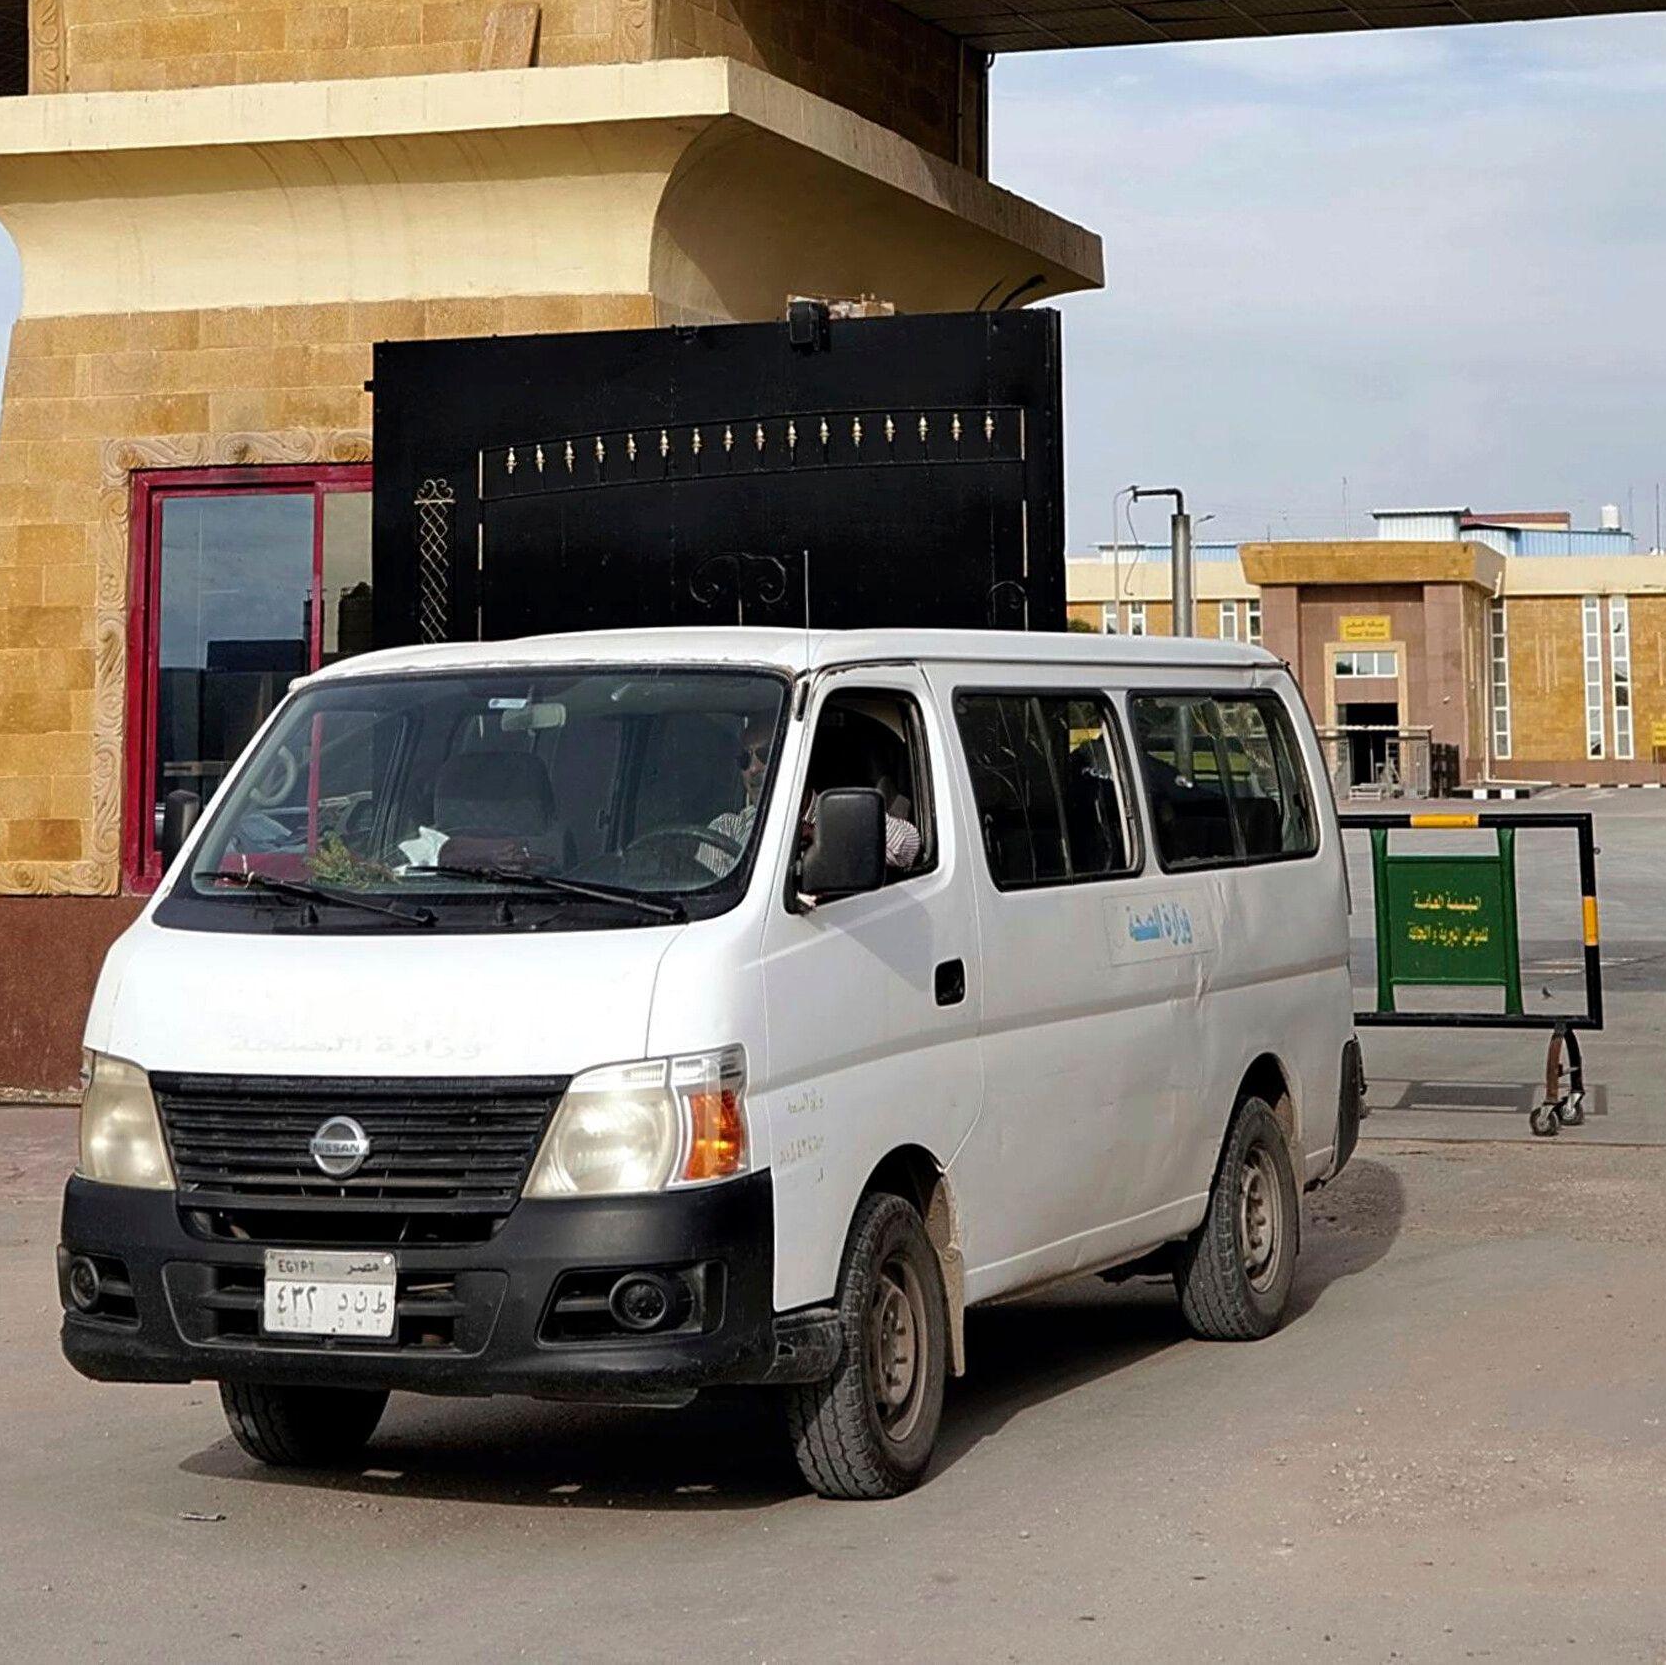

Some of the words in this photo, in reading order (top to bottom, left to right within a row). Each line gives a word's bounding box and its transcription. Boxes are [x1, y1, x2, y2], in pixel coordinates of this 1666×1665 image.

[312, 1140, 362, 1153] NISSAN
[277, 1259, 316, 1273] EGYPT
[346, 1262, 380, 1275] مصر
